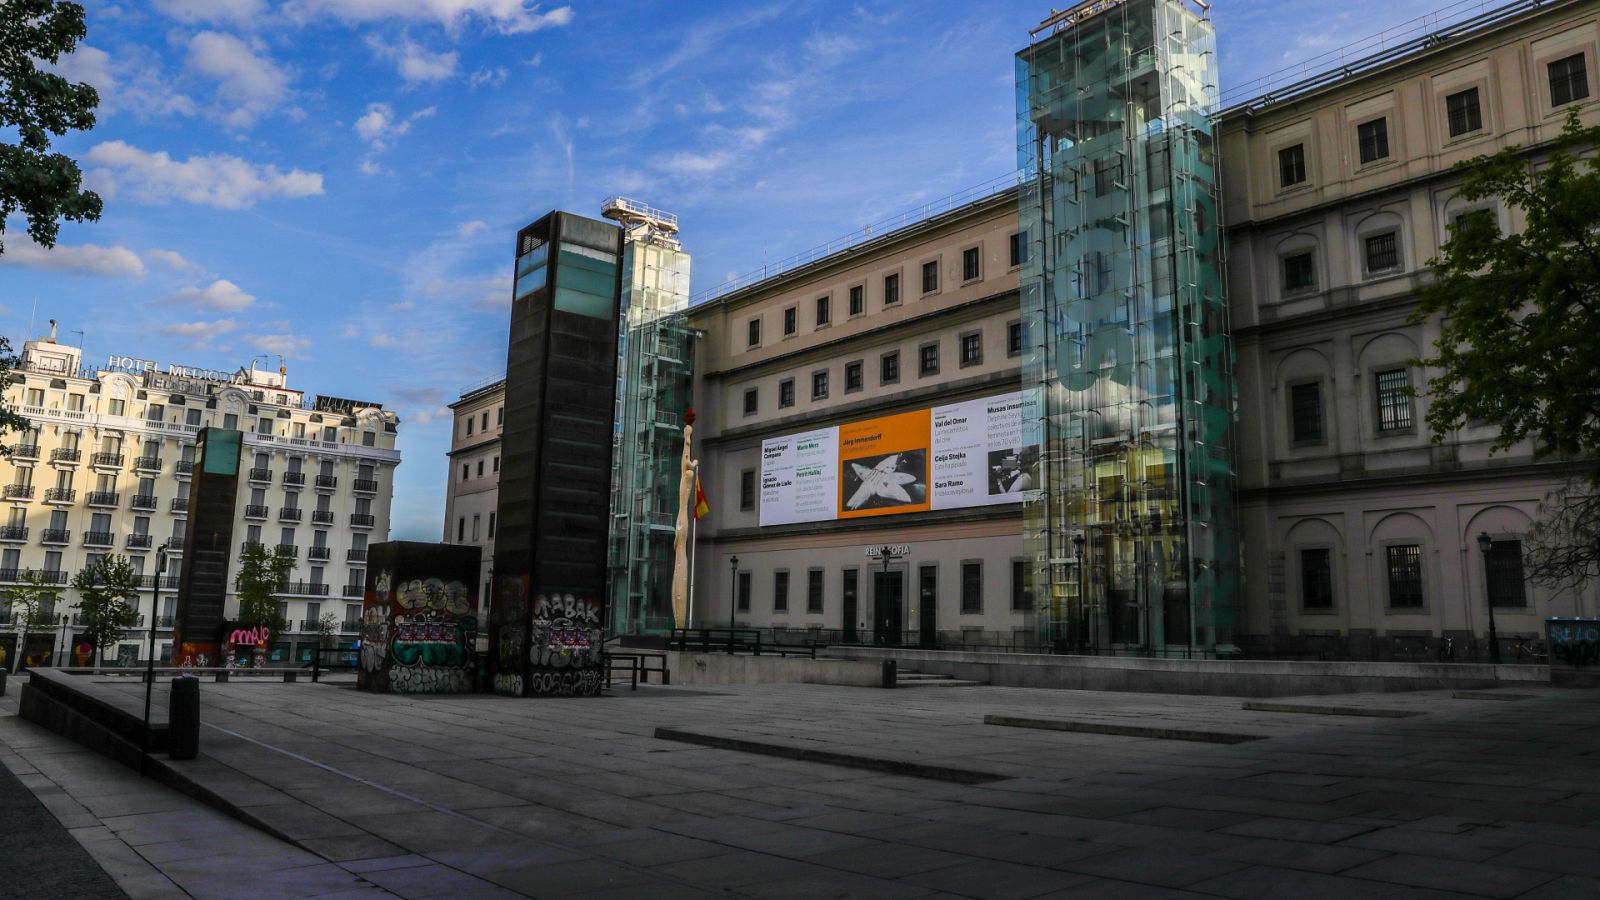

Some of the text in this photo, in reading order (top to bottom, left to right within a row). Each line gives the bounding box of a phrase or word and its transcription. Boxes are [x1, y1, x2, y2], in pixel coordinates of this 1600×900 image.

[109, 355, 161, 372] HOTEL
[987, 406, 1006, 414] Musas
[1006, 400, 1037, 411] insumisas
[935, 417, 968, 429] Val del Omar
[947, 480, 964, 488] Ramo
